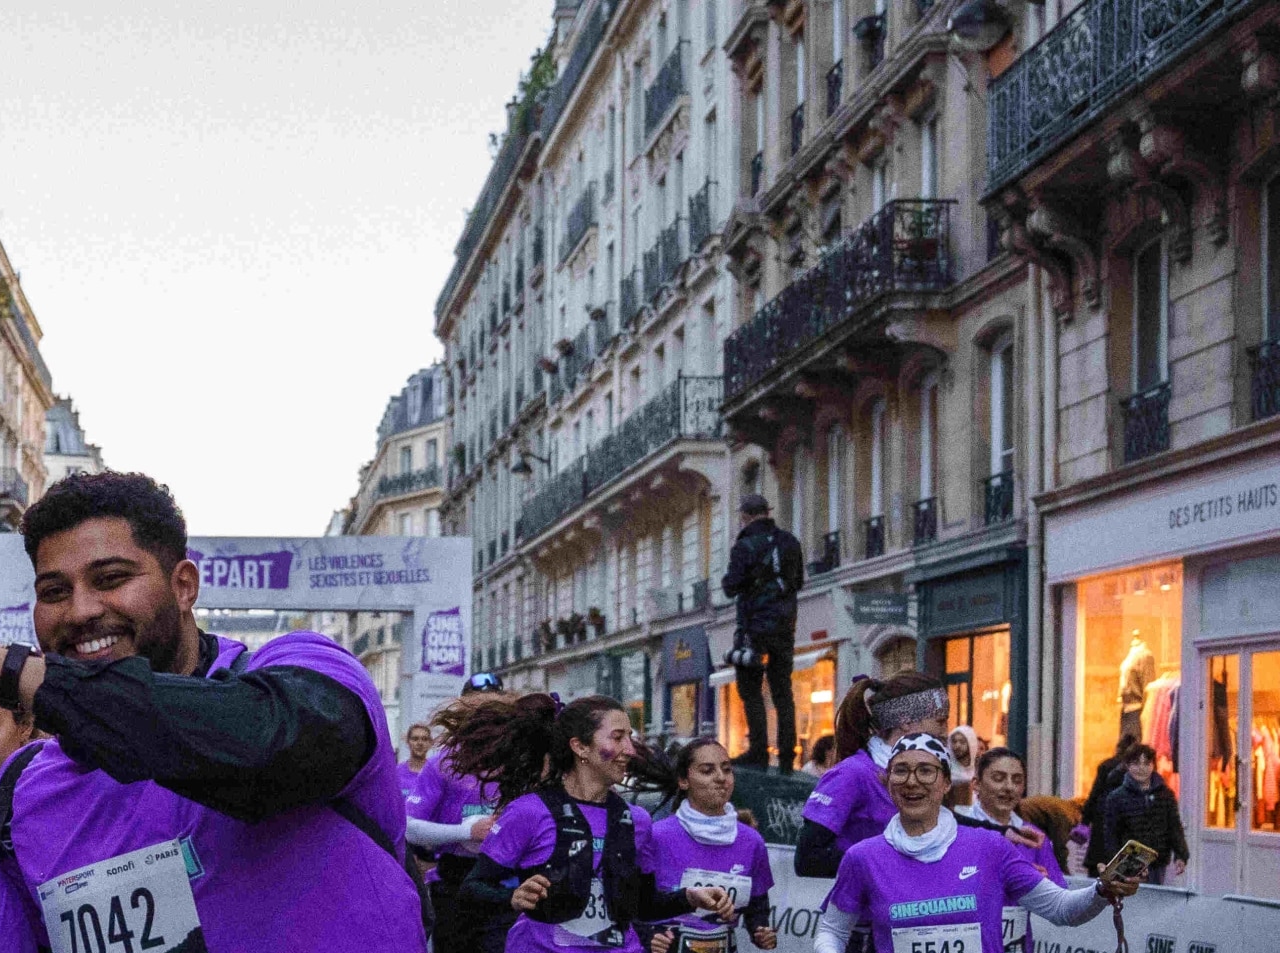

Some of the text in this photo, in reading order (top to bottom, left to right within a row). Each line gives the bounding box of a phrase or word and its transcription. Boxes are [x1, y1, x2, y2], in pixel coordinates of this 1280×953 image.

[1170, 484, 1278, 528] DES PETITS HAUTS
[359, 571, 371, 586] ET
[155, 848, 179, 861] PARIS
